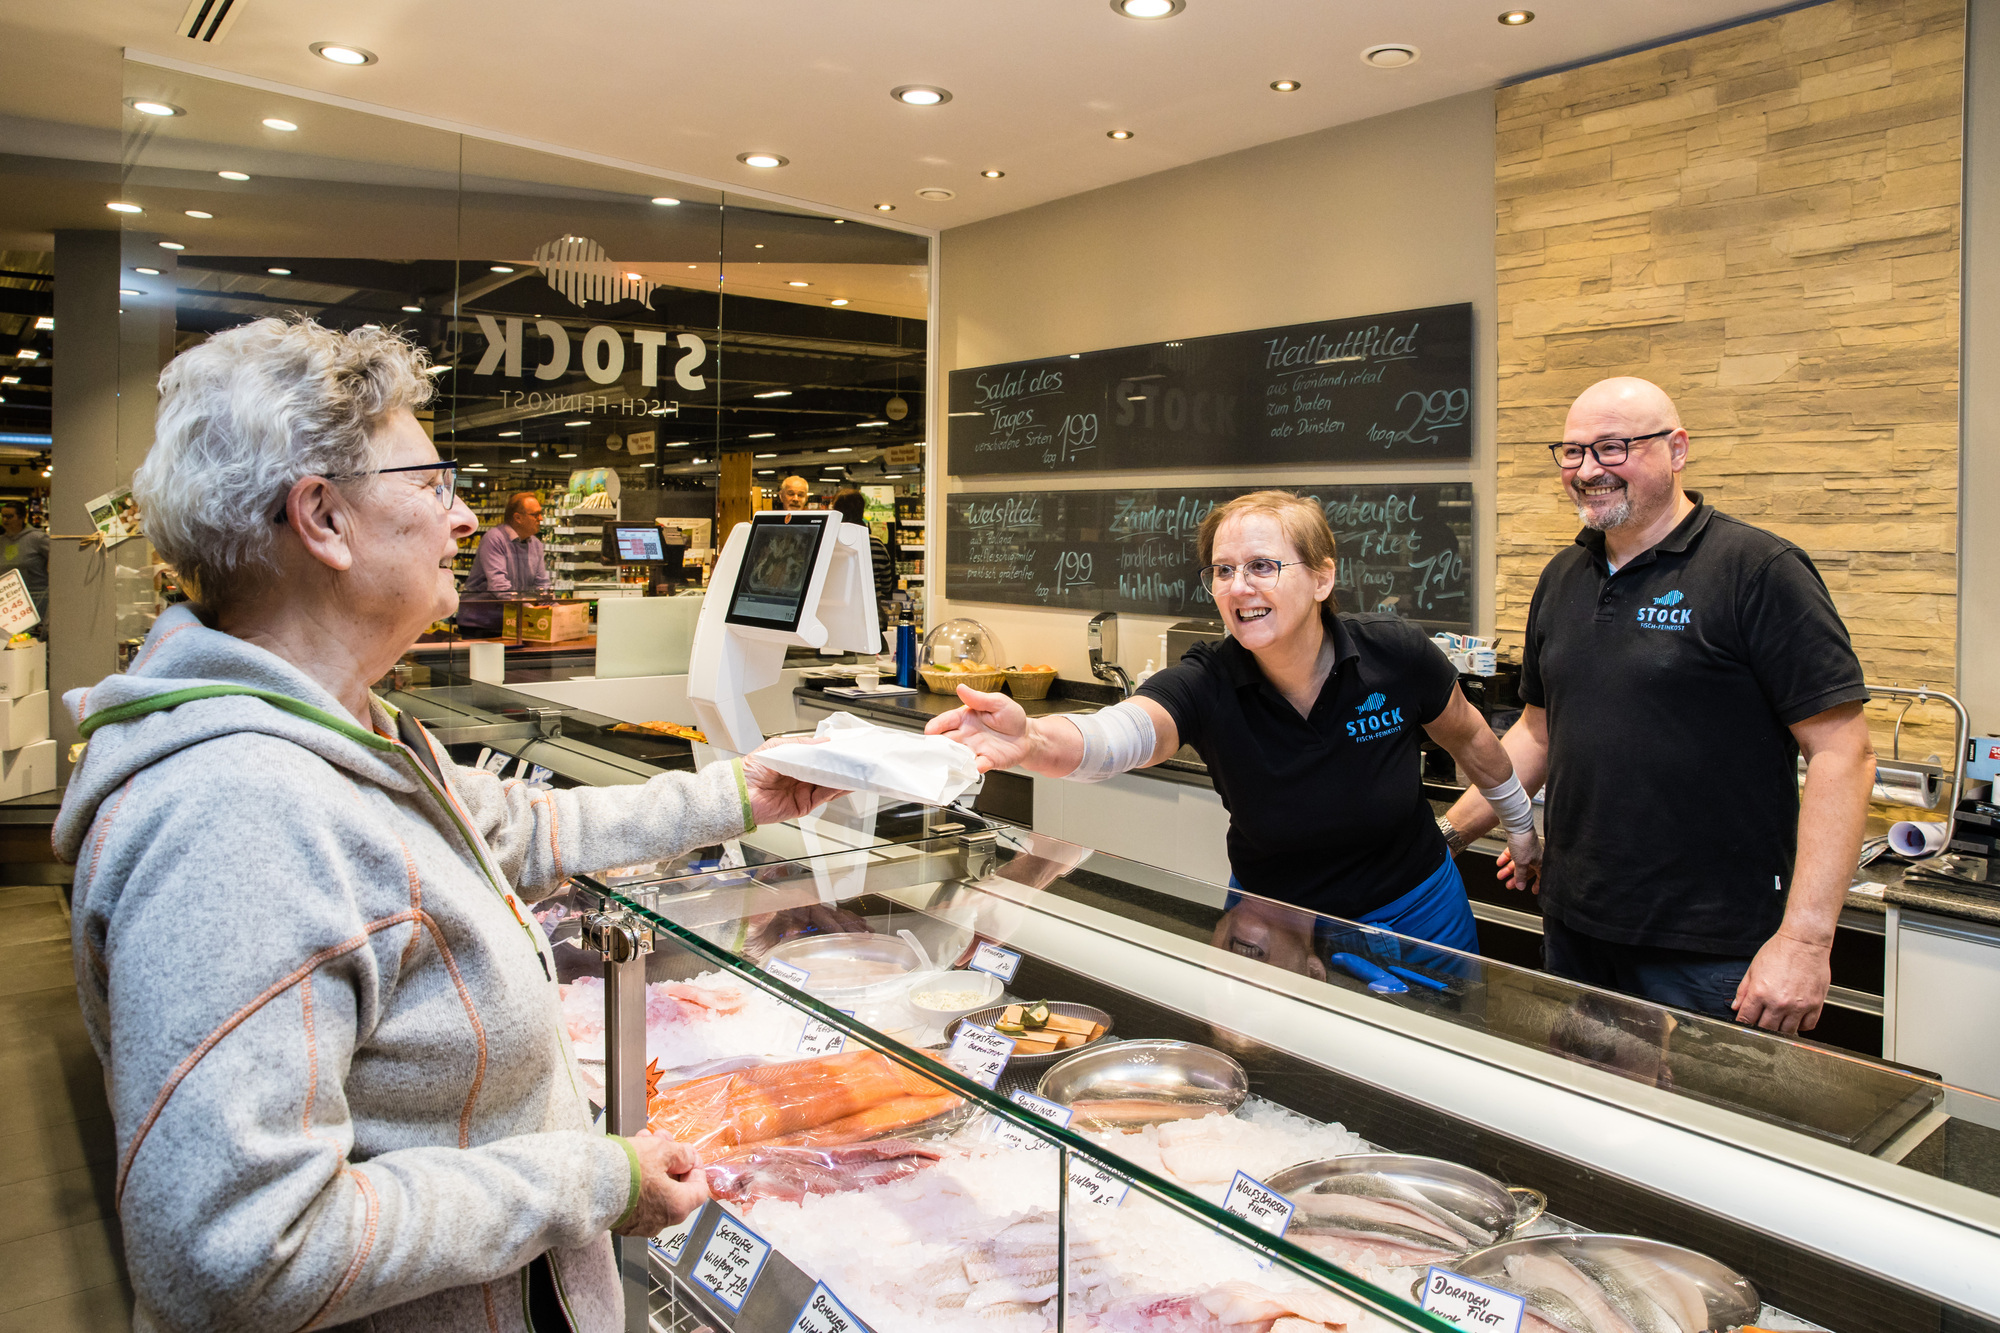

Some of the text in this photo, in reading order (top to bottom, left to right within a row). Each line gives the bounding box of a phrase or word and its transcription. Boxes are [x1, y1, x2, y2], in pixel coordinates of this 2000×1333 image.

[1264, 323, 1420, 370] Heilbuttfilet
[974, 369, 1063, 405] Salat des
[1266, 383, 1288, 396] aus
[990, 404, 1035, 437] Tages
[1271, 418, 1345, 438] oder Dünsten
[1025, 431, 1052, 447] Sorten
[1310, 494, 1424, 534] eeteufel
[1637, 607, 1692, 624] STOCK
[1346, 707, 1404, 737] STOCK
